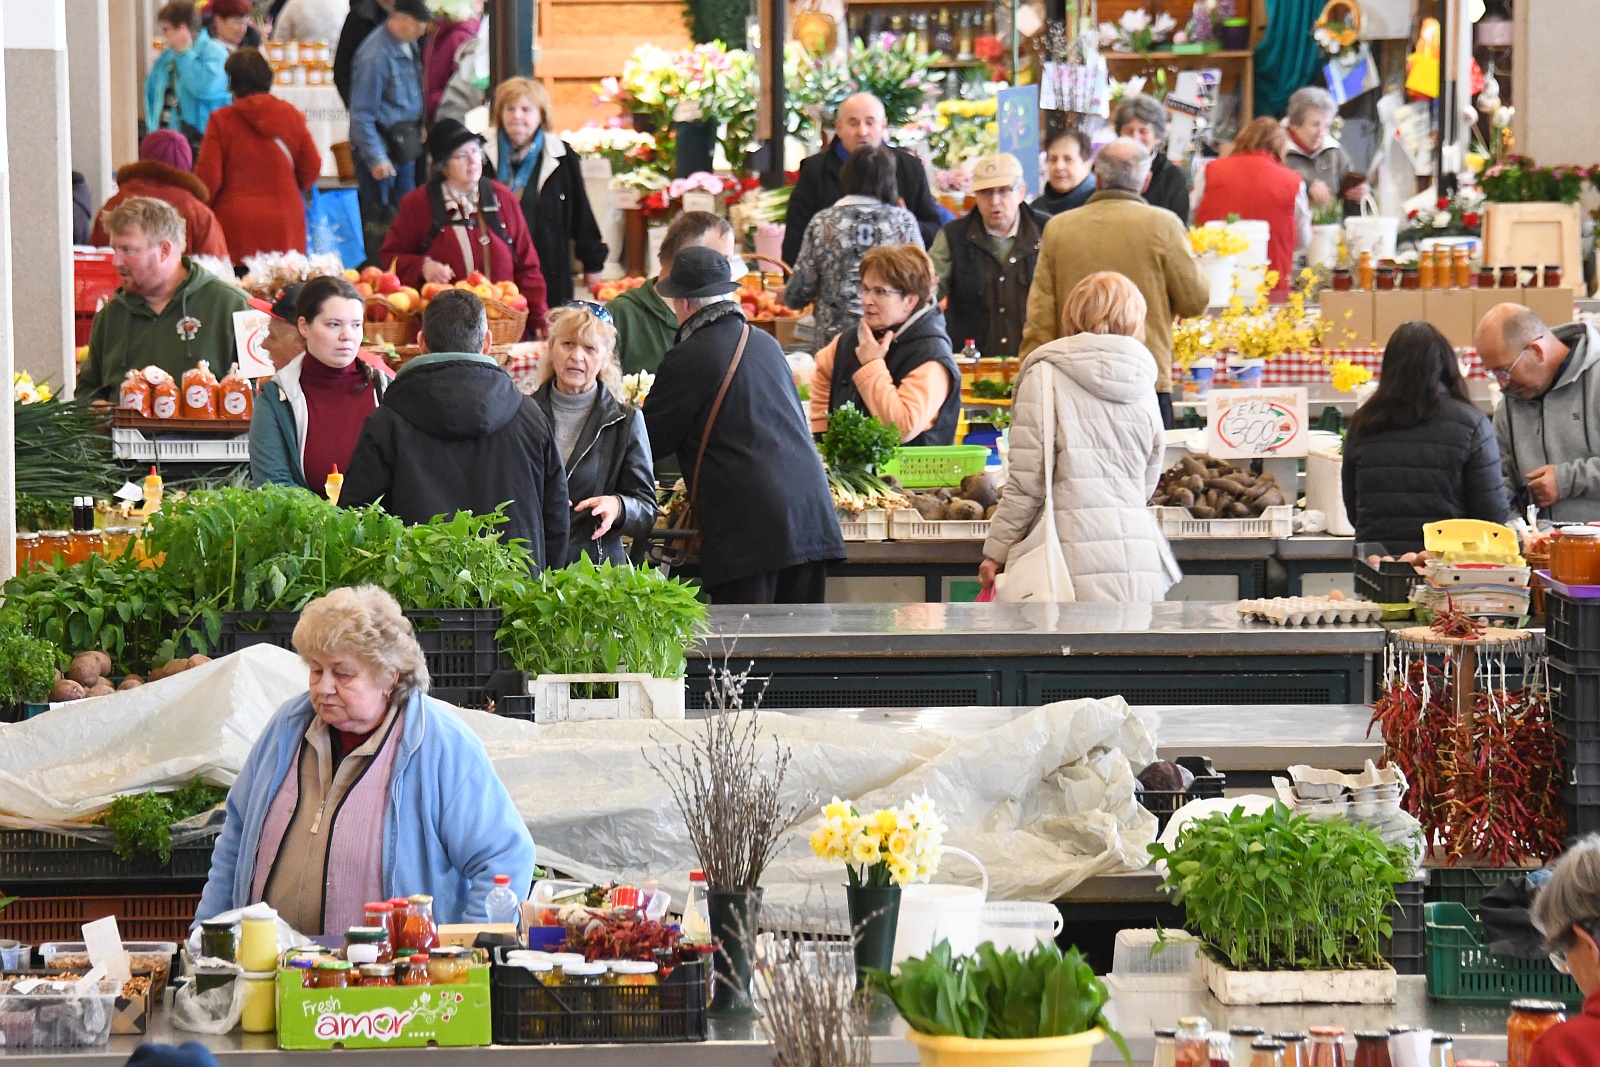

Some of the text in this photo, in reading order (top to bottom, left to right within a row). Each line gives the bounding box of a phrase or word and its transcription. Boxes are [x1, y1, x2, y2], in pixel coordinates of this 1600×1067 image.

[1231, 417, 1275, 448] 300
[302, 995, 341, 1017] Fresh
[317, 1013, 410, 1037] amor
